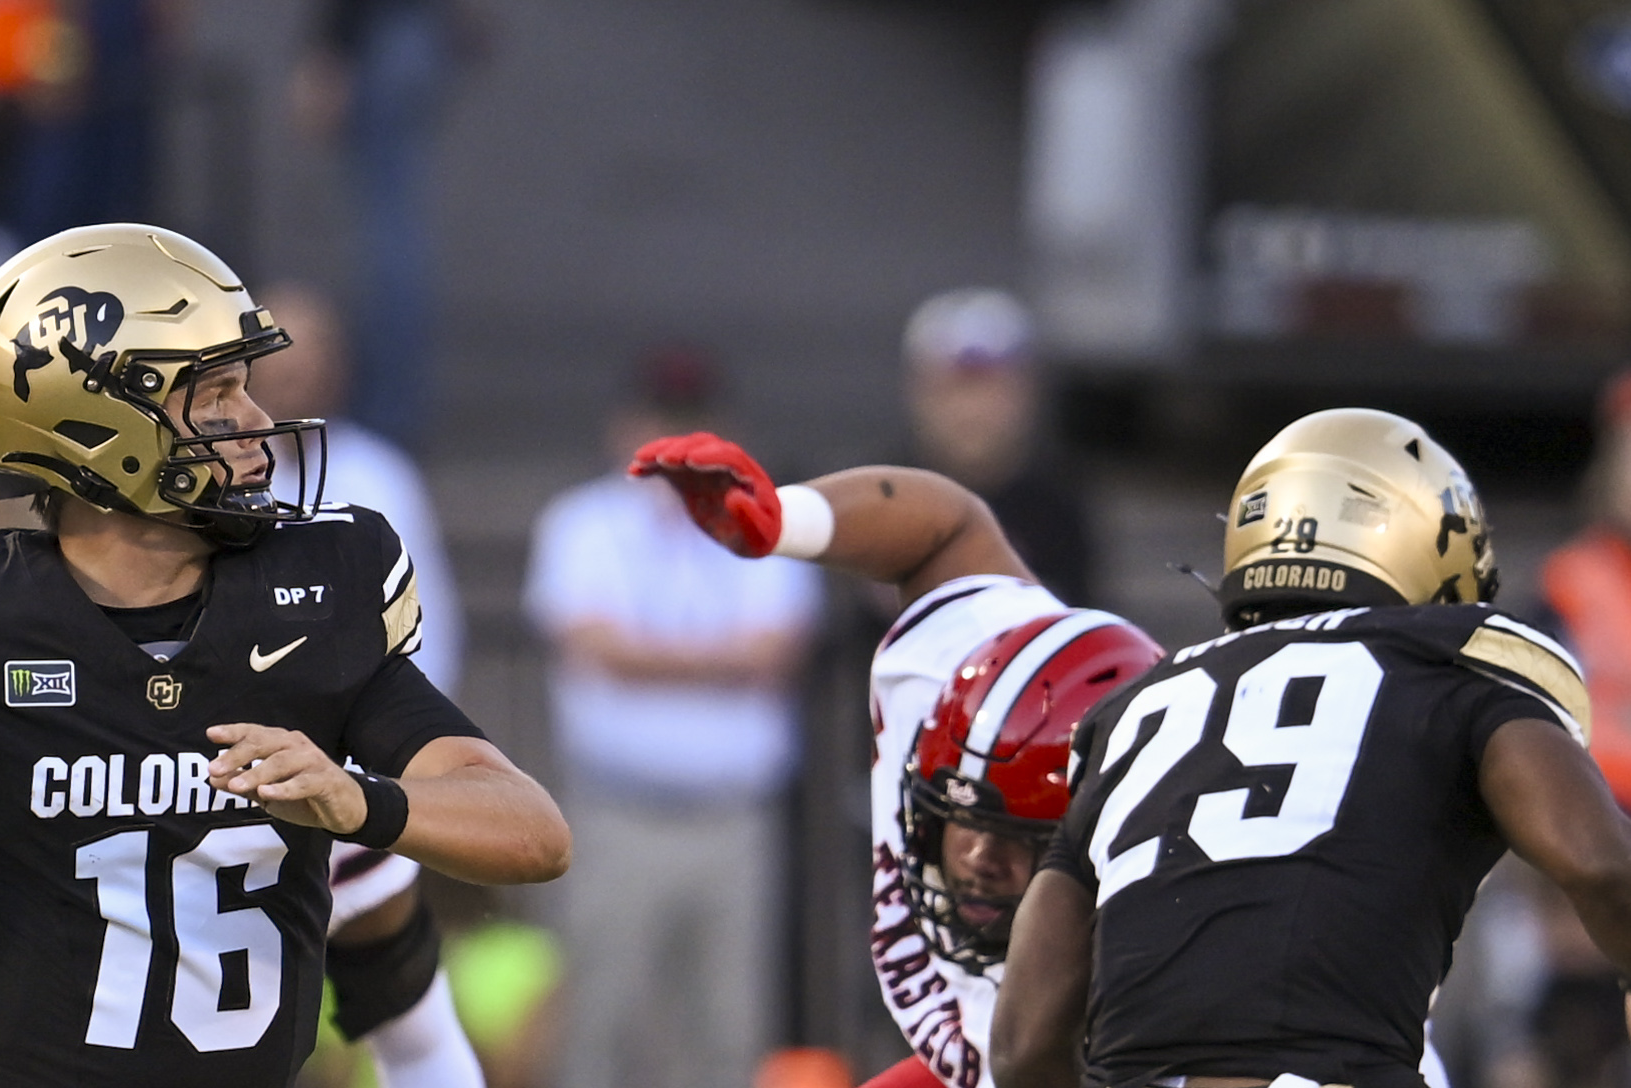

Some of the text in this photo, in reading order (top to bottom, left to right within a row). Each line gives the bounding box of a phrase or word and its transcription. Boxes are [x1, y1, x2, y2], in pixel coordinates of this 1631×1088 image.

[1271, 517, 1319, 554] 29
[274, 585, 325, 606] DP 7
[1243, 564, 1348, 592] COLORADO
[146, 674, 182, 710] CU
[30, 750, 265, 819] COLORA
[1088, 641, 1385, 910] 29
[75, 824, 289, 1052] 16
